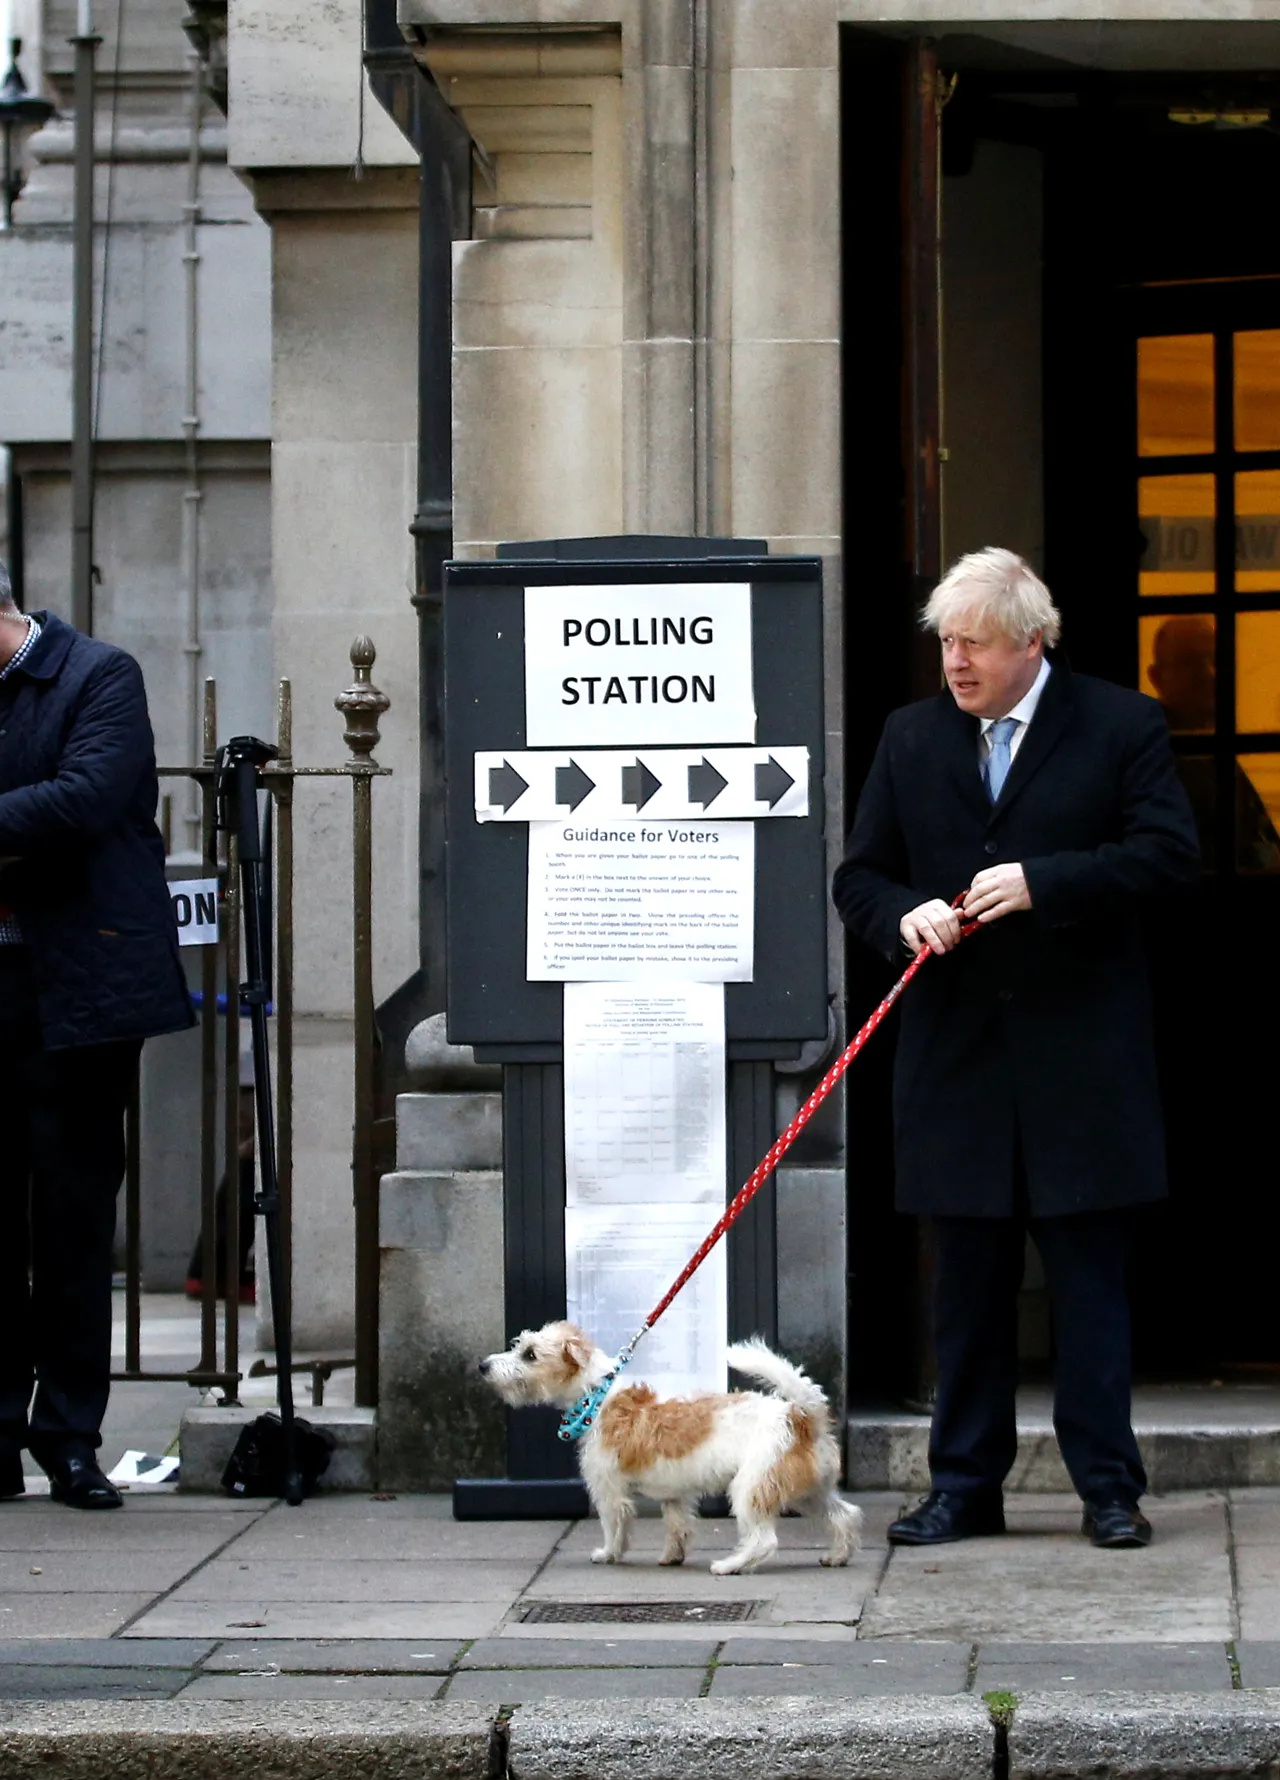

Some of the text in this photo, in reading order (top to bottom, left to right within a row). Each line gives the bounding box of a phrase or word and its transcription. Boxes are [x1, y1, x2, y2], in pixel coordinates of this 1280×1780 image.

[563, 616, 714, 647] POLLING
[561, 675, 716, 705] STATION
[562, 827, 719, 843] Guidance for Voters
[171, 892, 216, 927] ON
